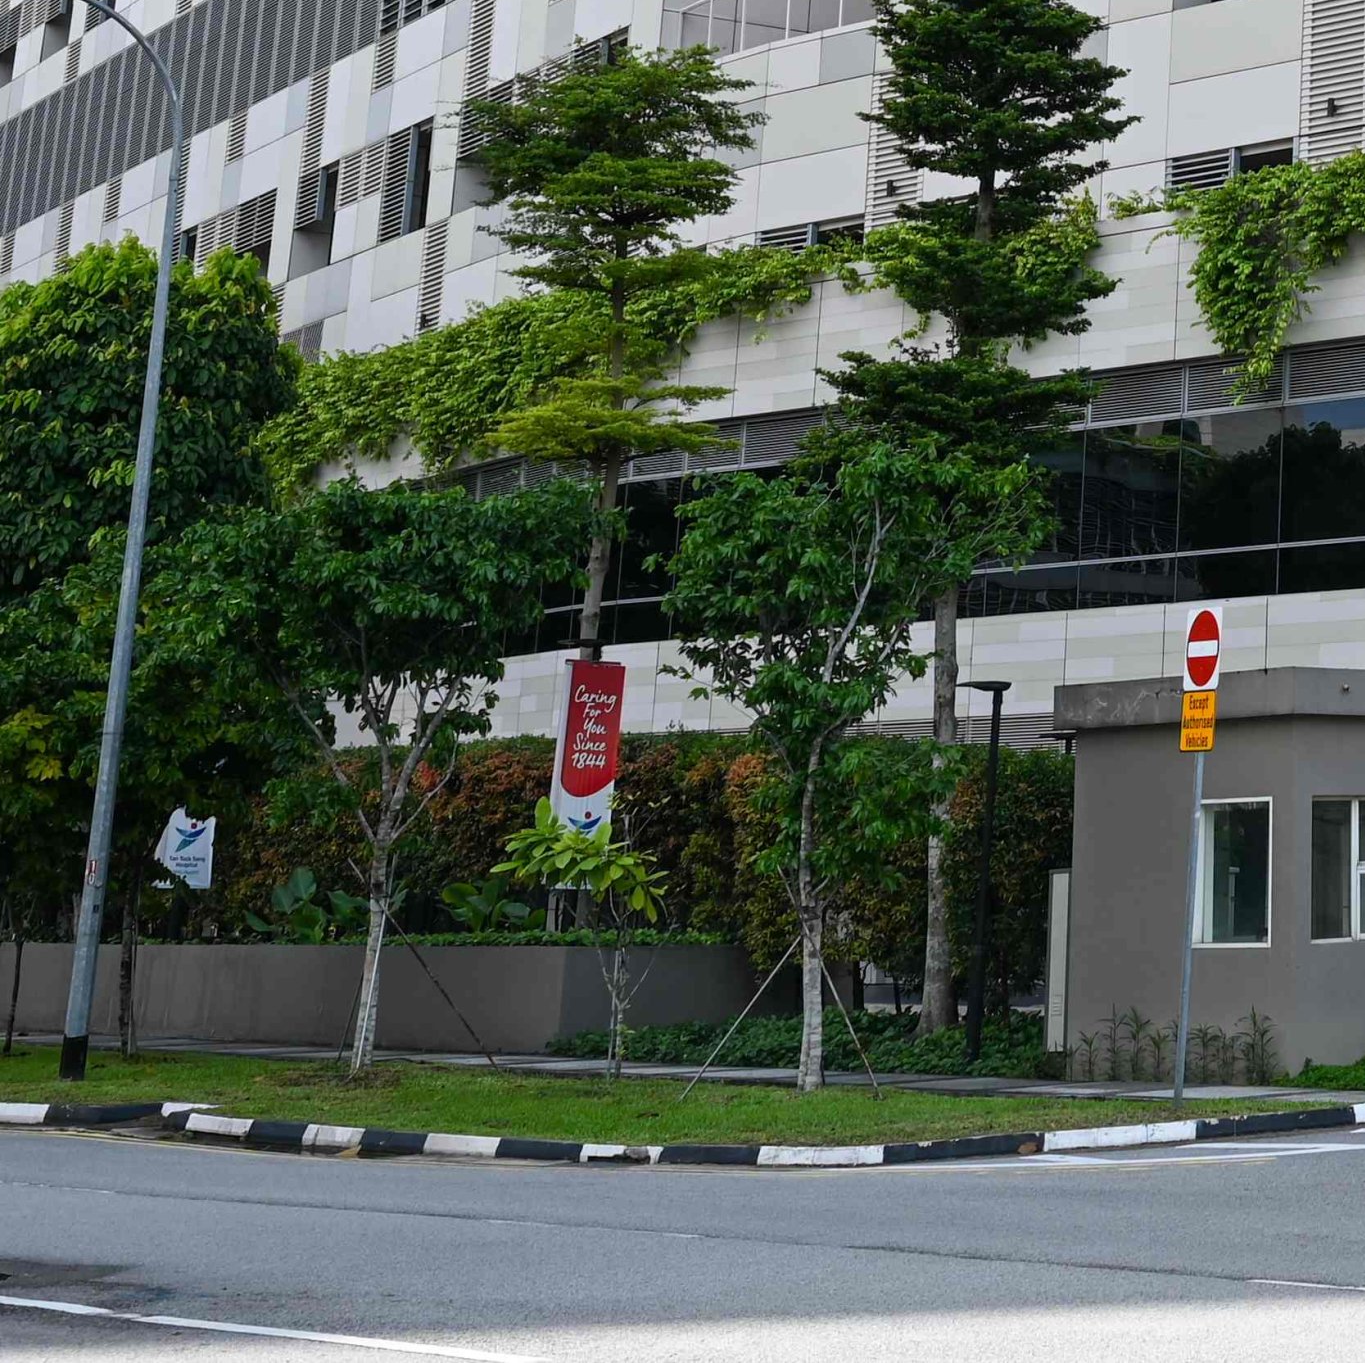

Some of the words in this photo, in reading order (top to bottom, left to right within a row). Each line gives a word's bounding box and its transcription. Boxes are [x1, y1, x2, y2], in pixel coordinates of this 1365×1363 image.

[575, 684, 617, 713] Caring
[583, 703, 602, 718] For
[583, 718, 608, 738] You
[573, 733, 608, 751] Since
[571, 752, 607, 769] 1844
